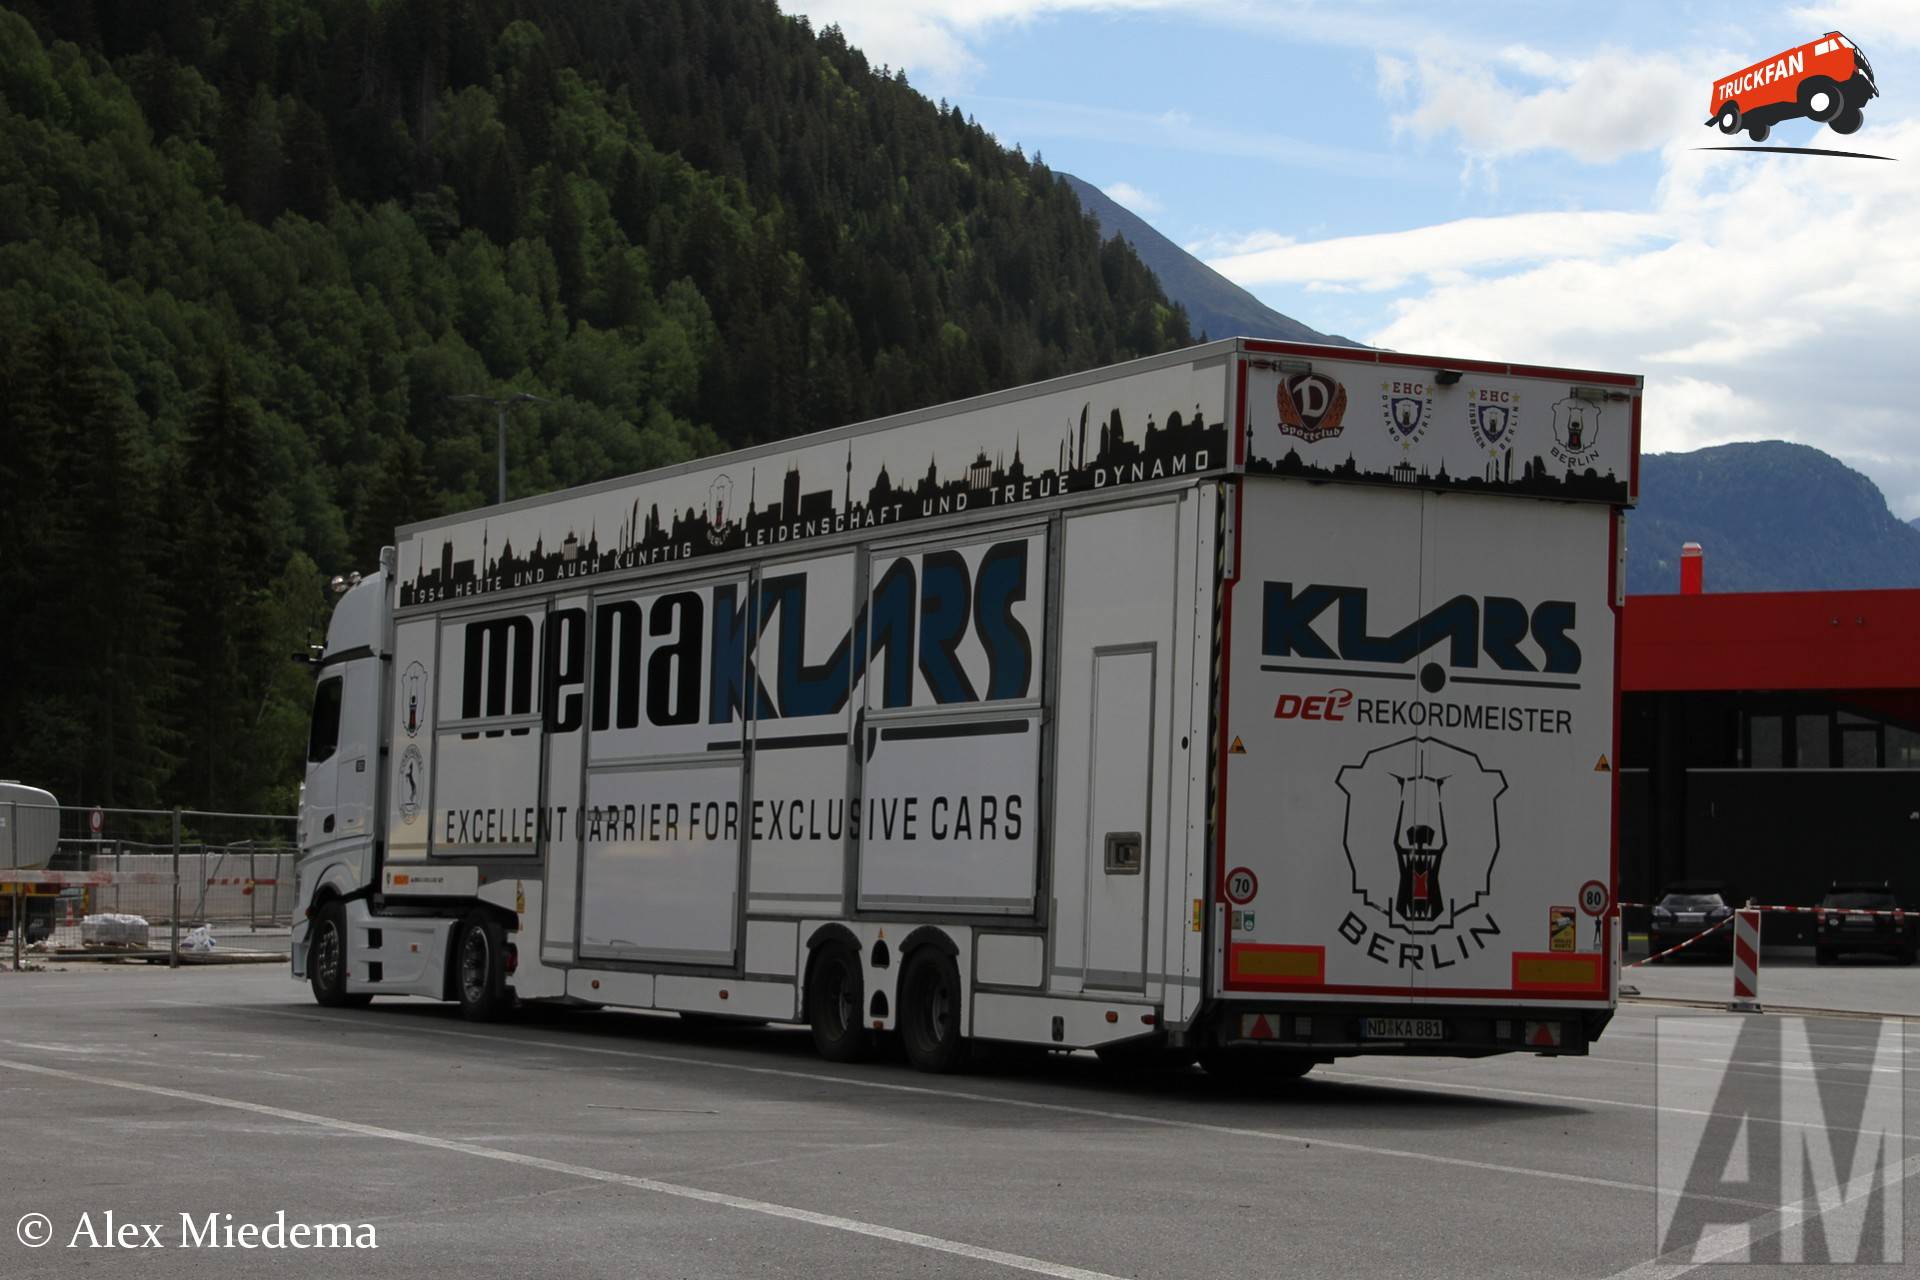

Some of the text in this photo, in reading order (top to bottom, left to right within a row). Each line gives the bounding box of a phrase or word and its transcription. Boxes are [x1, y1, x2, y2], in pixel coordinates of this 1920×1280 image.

[1391, 381, 1424, 396] EHC
[1479, 389, 1510, 404] EHC
[1281, 422, 1341, 442] Sportclub
[1382, 394, 1401, 443] DYNAMO
[1412, 398, 1433, 444] BERLIN
[1499, 405, 1520, 451] BERLIN
[1550, 446, 1600, 468] BERLIN
[744, 450, 1209, 548] LEIDENSCHAFT UND TREUE DYNAMO
[410, 541, 693, 605] 1954 HEUTE UND AUCH KÜNFTIG
[1262, 580, 1582, 675] KLARS
[1357, 698, 1573, 735] REKORDMEISTER
[446, 806, 567, 844] EXCELLENT
[689, 800, 738, 841] FOR
[751, 796, 918, 841] EXCLUSIVE
[931, 793, 1023, 841] CARS
[1234, 878, 1250, 893] 70
[1586, 890, 1602, 906] 80
[1338, 911, 1501, 971] BERLIN
[1367, 1019, 1441, 1038] ND KA 881
